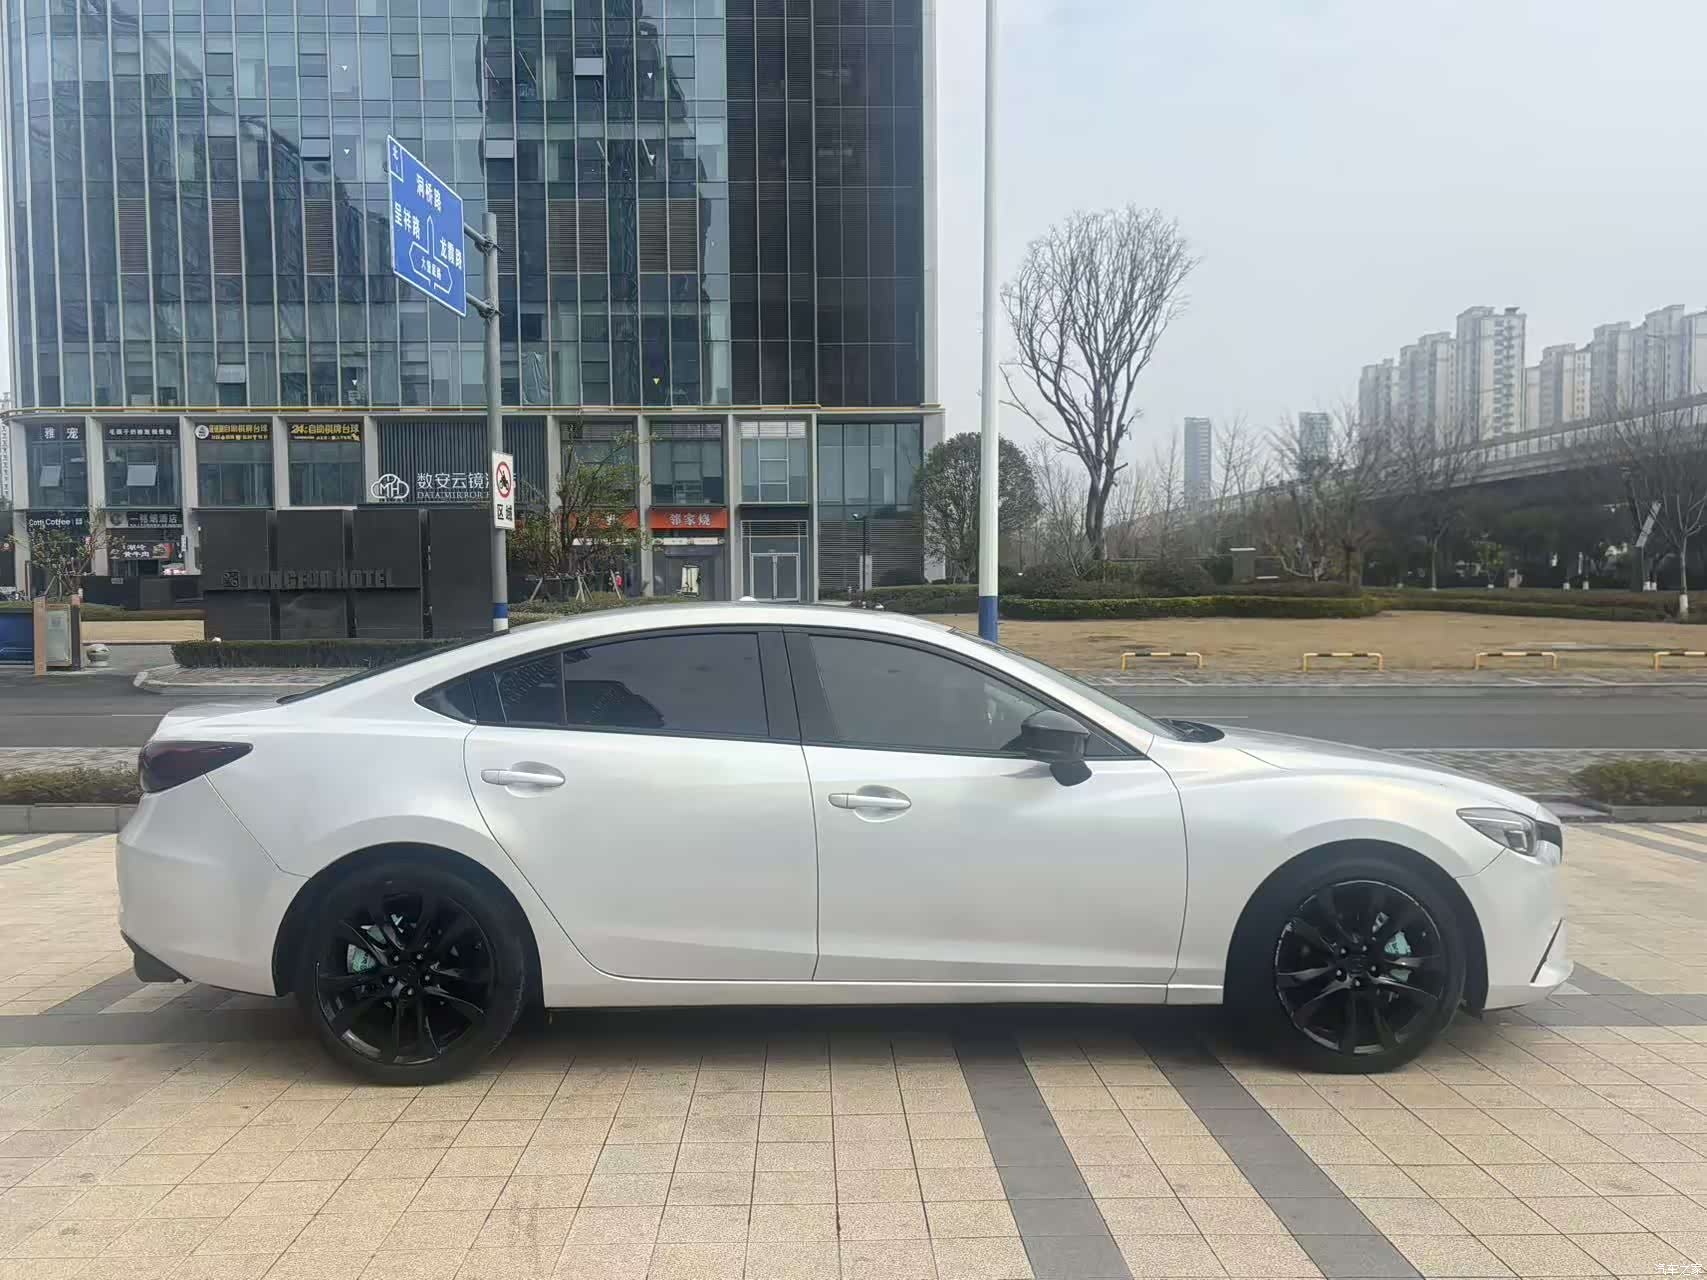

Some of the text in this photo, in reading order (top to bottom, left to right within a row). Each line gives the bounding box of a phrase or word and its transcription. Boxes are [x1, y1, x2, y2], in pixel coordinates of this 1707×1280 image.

[394, 201, 421, 241] 呈祥路
[45, 518, 71, 526] Coffee
[336, 568, 396, 589] HOTEL
